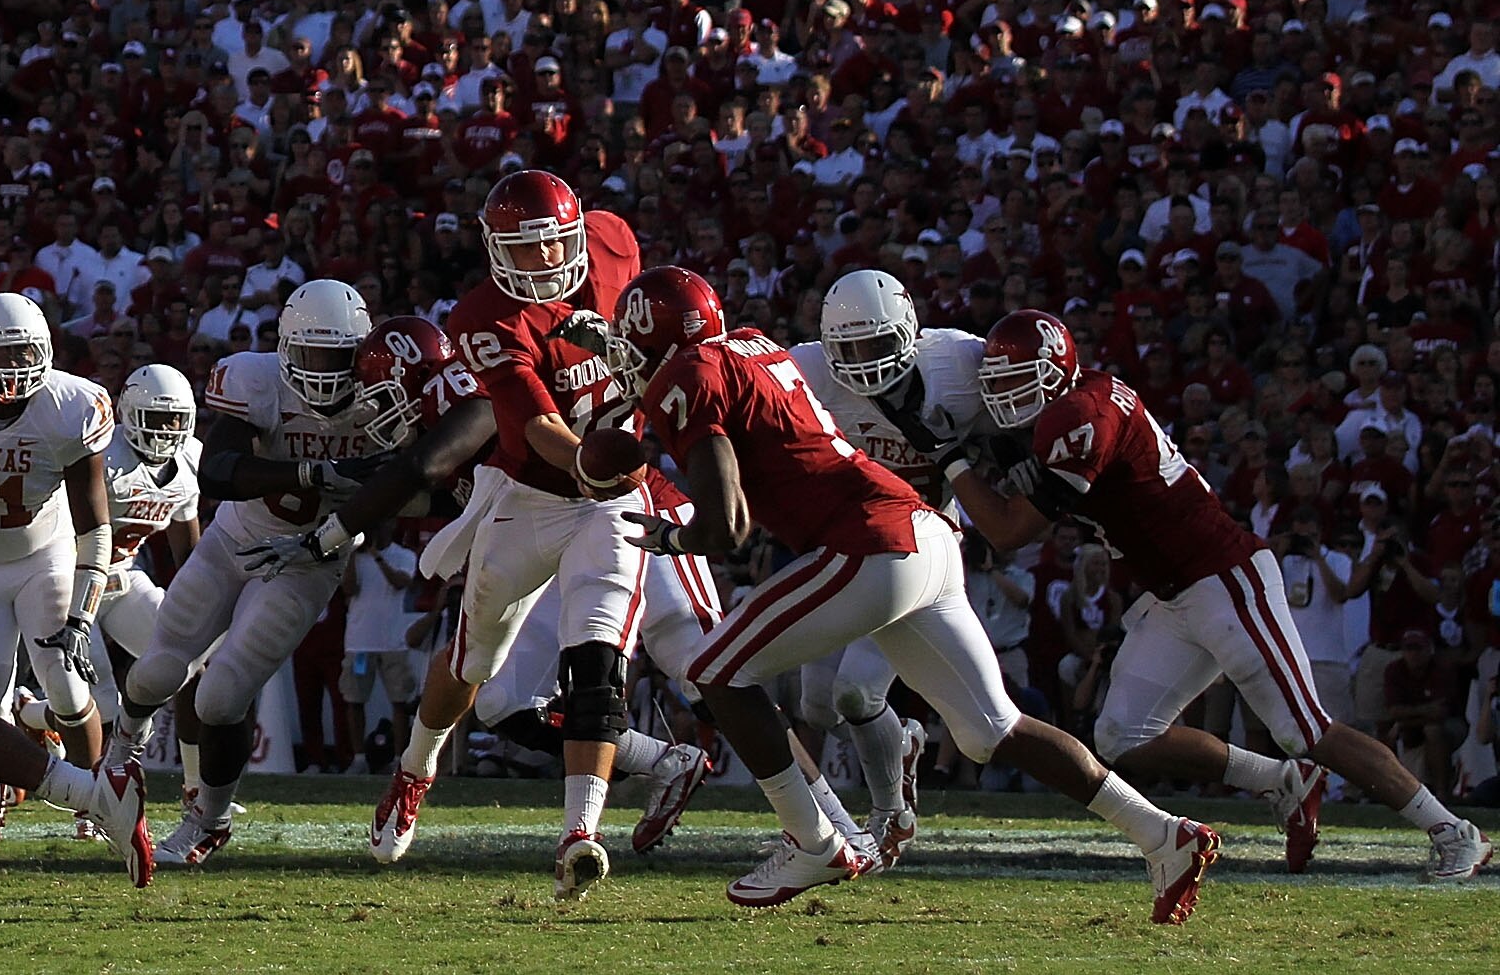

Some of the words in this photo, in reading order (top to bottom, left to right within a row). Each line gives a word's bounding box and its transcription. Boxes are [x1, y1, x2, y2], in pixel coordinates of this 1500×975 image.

[626, 288, 654, 334] OU
[385, 331, 421, 366] OU
[459, 331, 512, 372] 12
[1036, 319, 1067, 357] OU
[422, 365, 478, 416] 76
[554, 355, 611, 393] SOON
[659, 384, 688, 431] 7
[762, 359, 857, 459] 7
[285, 433, 367, 461] TEXAS
[866, 436, 935, 465] TEXA
[1048, 422, 1094, 464] 47
[126, 500, 174, 521] TEXAS
